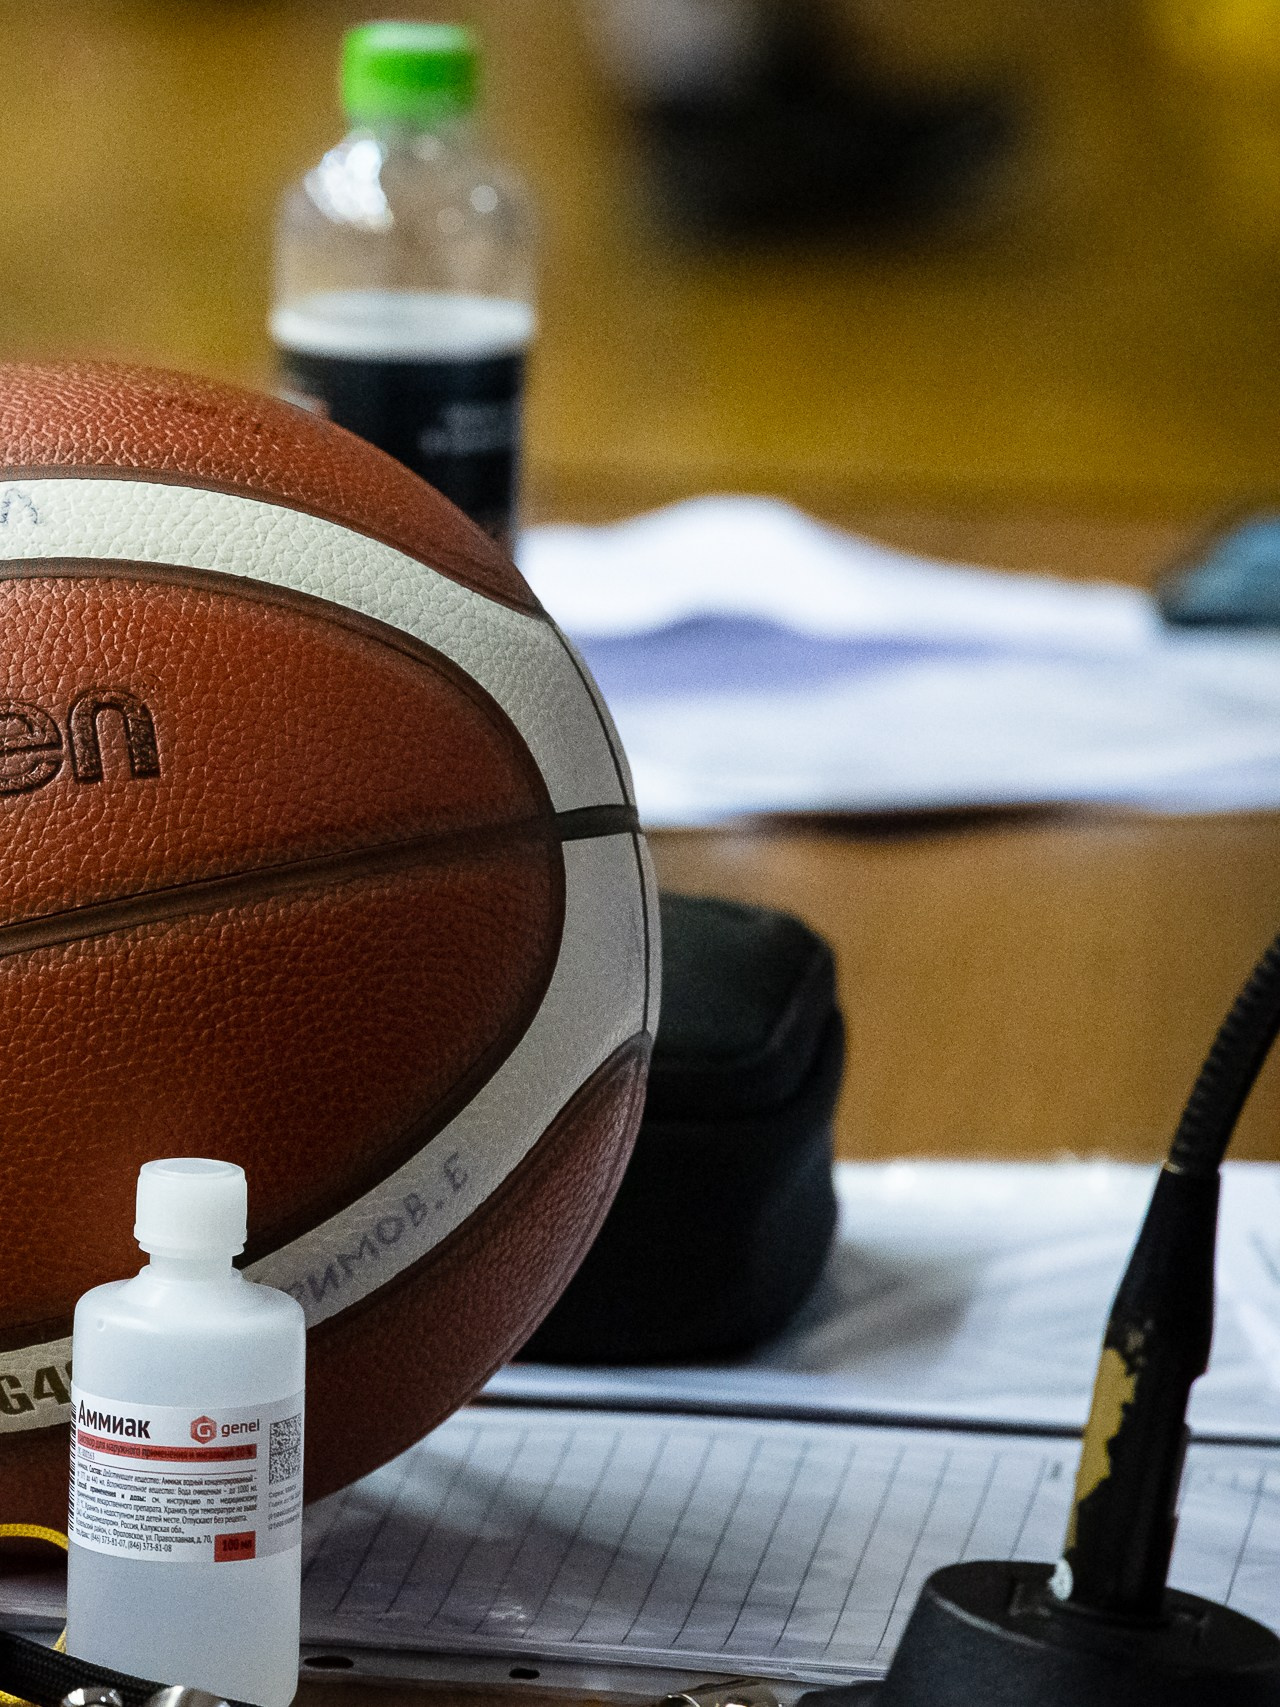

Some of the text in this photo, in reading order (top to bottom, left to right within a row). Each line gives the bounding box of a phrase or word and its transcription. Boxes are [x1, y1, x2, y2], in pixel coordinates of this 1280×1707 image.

[78, 1399, 151, 1439] Аммиак
[221, 1418, 260, 1438] genel
[178, 1486, 191, 1495] Вода
[97, 1497, 132, 1510] лекарственного
[164, 1506, 187, 1515] Хранить
[189, 1507, 199, 1516] при
[201, 1507, 235, 1515] температуре
[167, 1498, 201, 1506] инструкцию
[220, 1495, 257, 1504] медицинскому
[104, 1509, 134, 1520] недоступном
[135, 1514, 144, 1522] для
[146, 1514, 161, 1522] детей
[163, 1516, 180, 1524] месте.
[182, 1516, 213, 1526] Отпускают
[214, 1515, 223, 1523] без
[121, 1520, 139, 1531] Россия,
[140, 1522, 169, 1533] Калужская
[113, 1529, 144, 1541] Фроловское,
[154, 1534, 196, 1545] Православная,
[203, 1535, 212, 1544] 70,
[128, 1540, 141, 1552] (846)
[143, 1542, 172, 1553] 373-81-08
[222, 1538, 252, 1552] 100 мл
